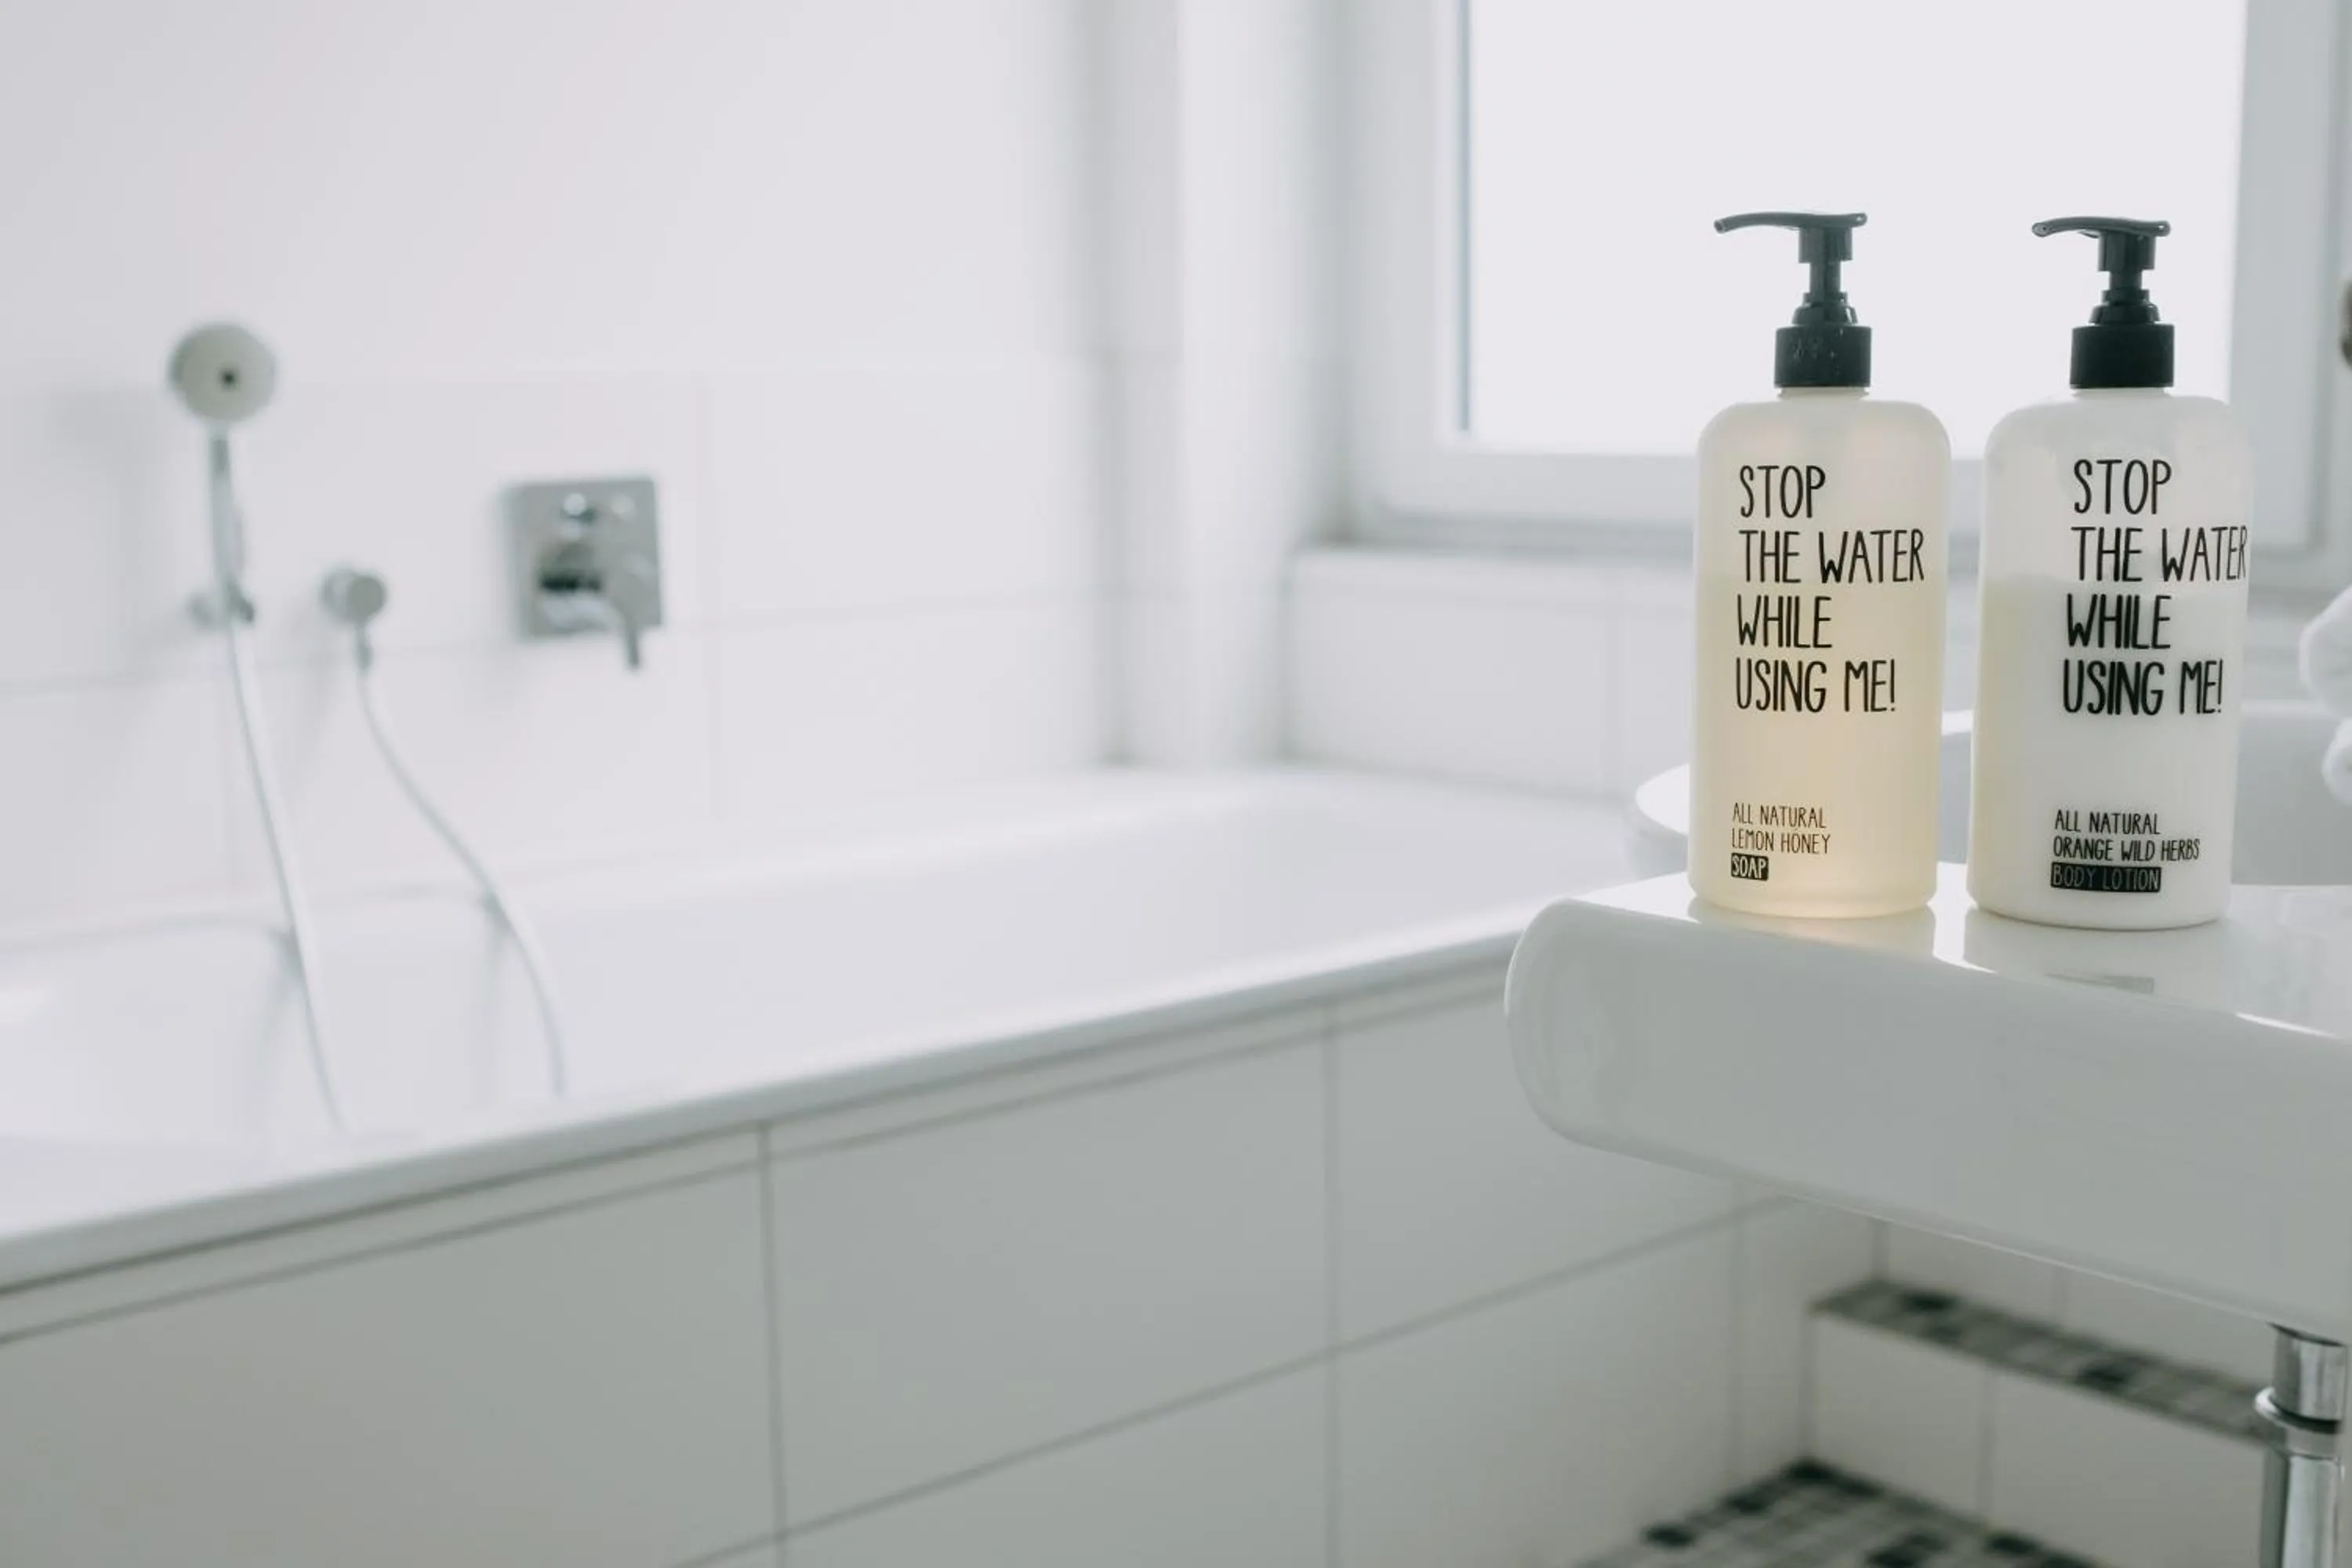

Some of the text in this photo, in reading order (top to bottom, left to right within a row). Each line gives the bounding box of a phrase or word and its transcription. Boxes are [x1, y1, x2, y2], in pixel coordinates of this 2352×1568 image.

[1740, 465, 1825, 518] STOP
[2074, 459, 2172, 514] STOP
[1739, 528, 1924, 584] THE WATER
[2071, 525, 2247, 583] THE WATER
[1737, 594, 1832, 648] WHILE
[2067, 593, 2171, 649] WHILE
[1736, 657, 1895, 713] USING ME!
[2063, 659, 2223, 715] USING ME!
[1731, 828, 1831, 854] LEMON HONEY
[1733, 803, 1826, 828] ALL NATURAL
[2055, 810, 2160, 834] ALL NATURAL
[1732, 855, 1766, 879] SOAP
[2053, 836, 2199, 862] ORANGE WILD HERBS
[2053, 866, 2158, 891] BODY LOTION
